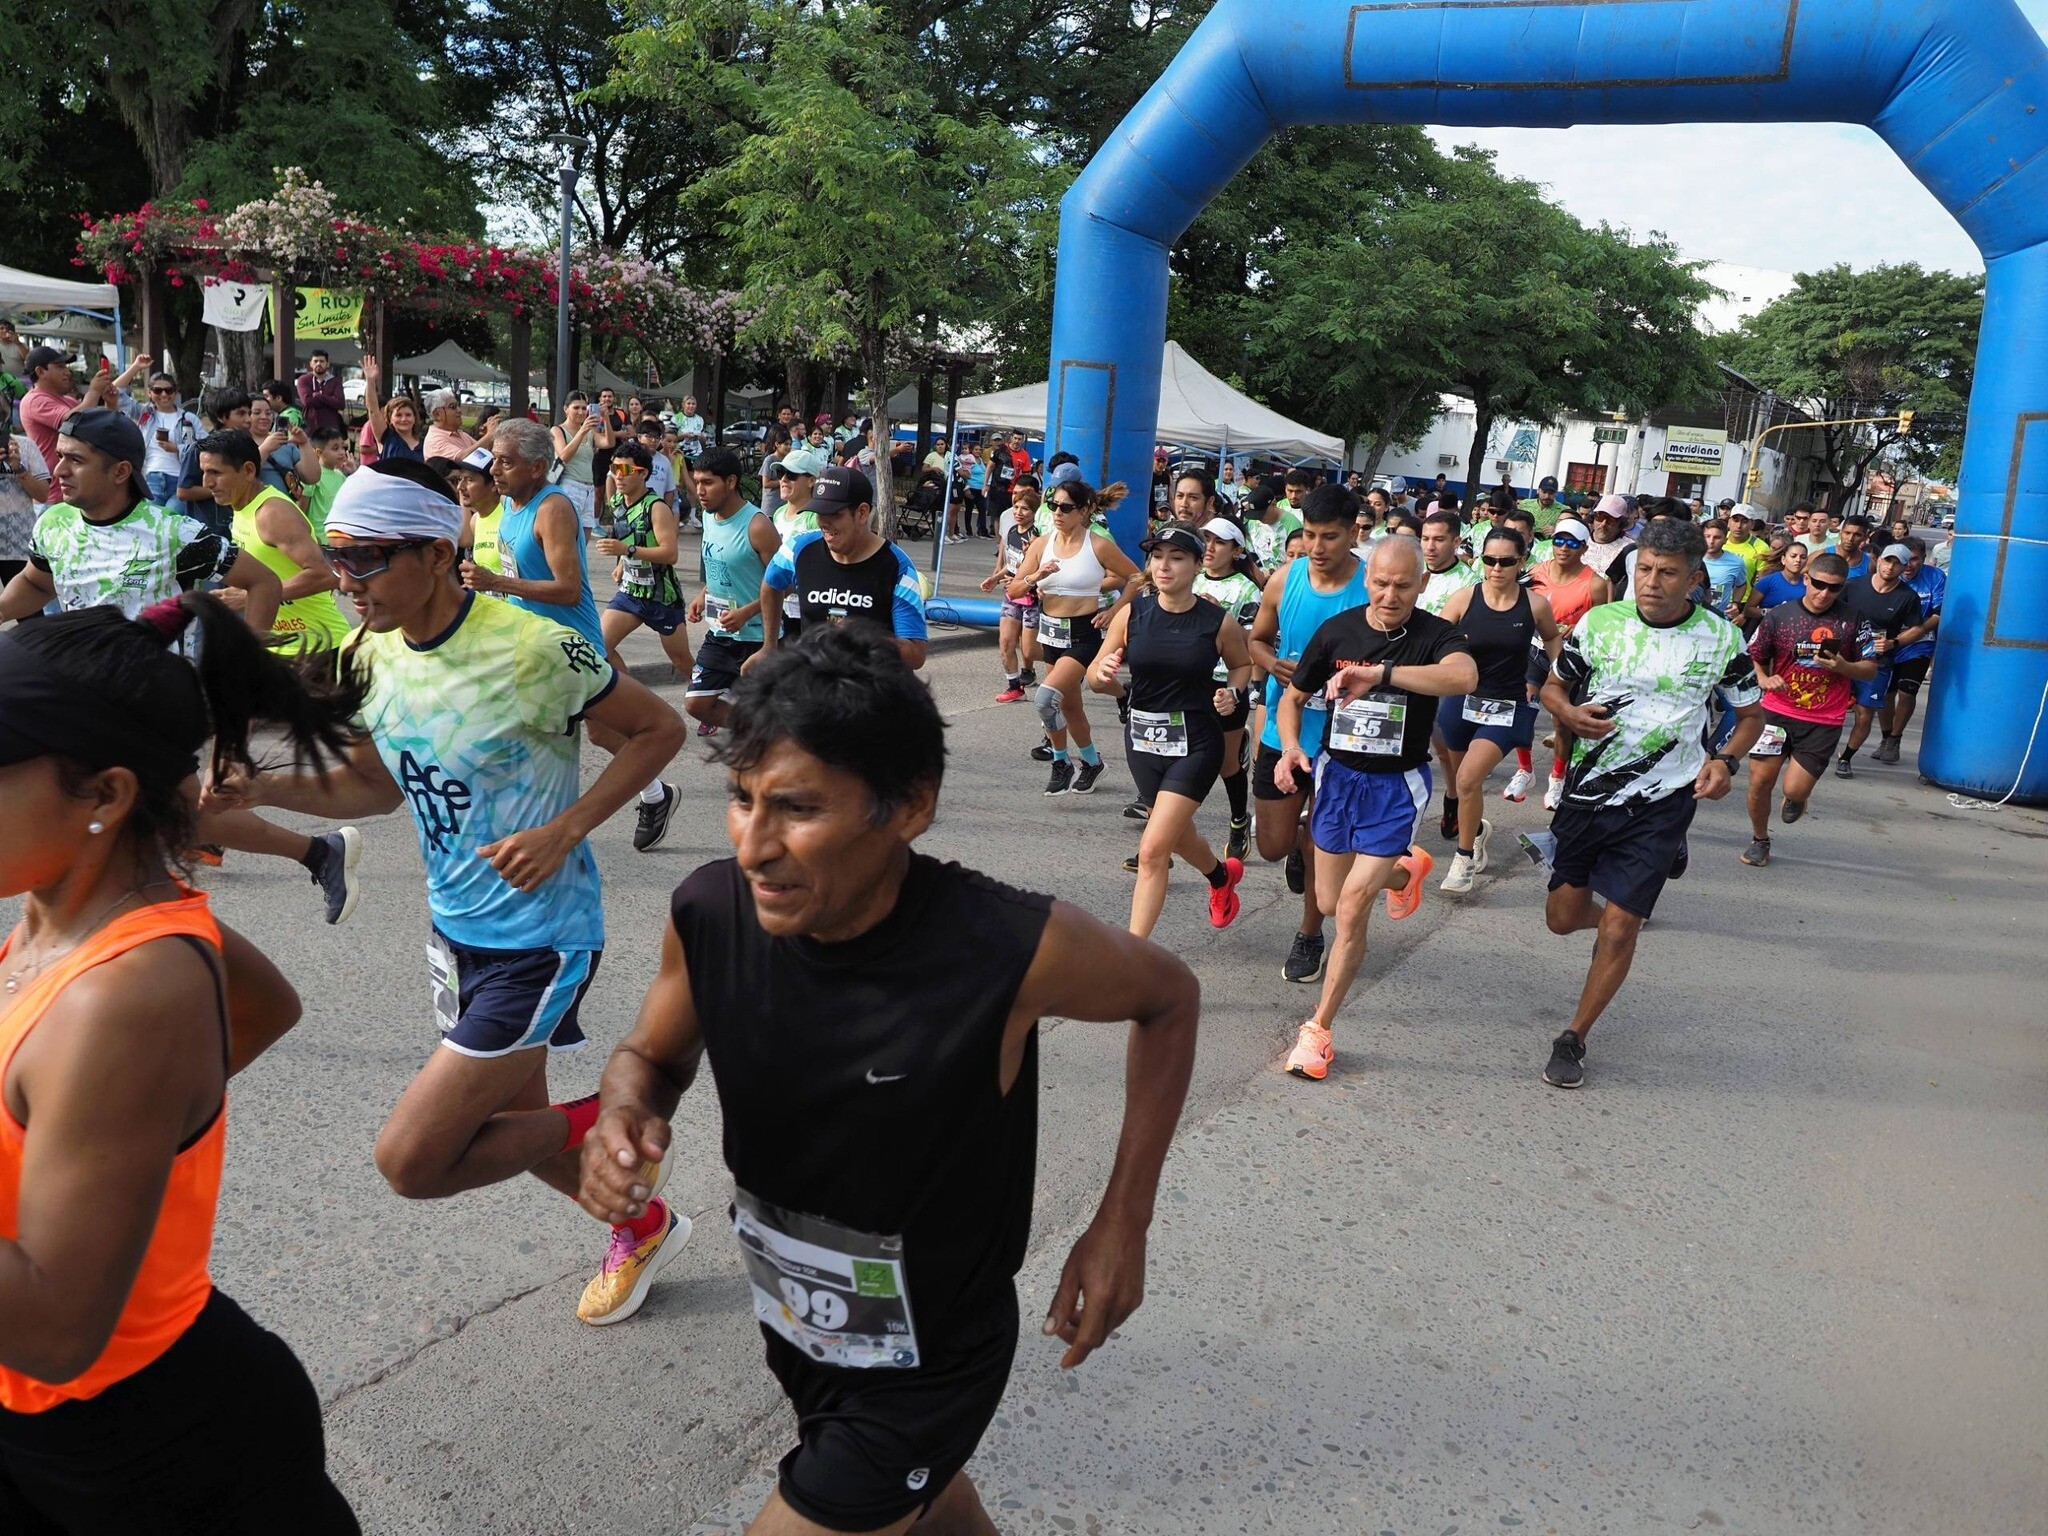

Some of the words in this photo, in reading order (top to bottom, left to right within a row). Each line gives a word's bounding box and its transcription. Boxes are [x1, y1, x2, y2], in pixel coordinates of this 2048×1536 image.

[321, 297, 358, 309] RIOT
[1670, 445, 1719, 455] meridiano
[807, 587, 874, 608] adidas
[1049, 627, 1056, 638] 5
[1481, 701, 1501, 714] 74
[1352, 718, 1382, 737] 55
[1144, 727, 1168, 742] 42
[886, 1322, 909, 1334] 10K
